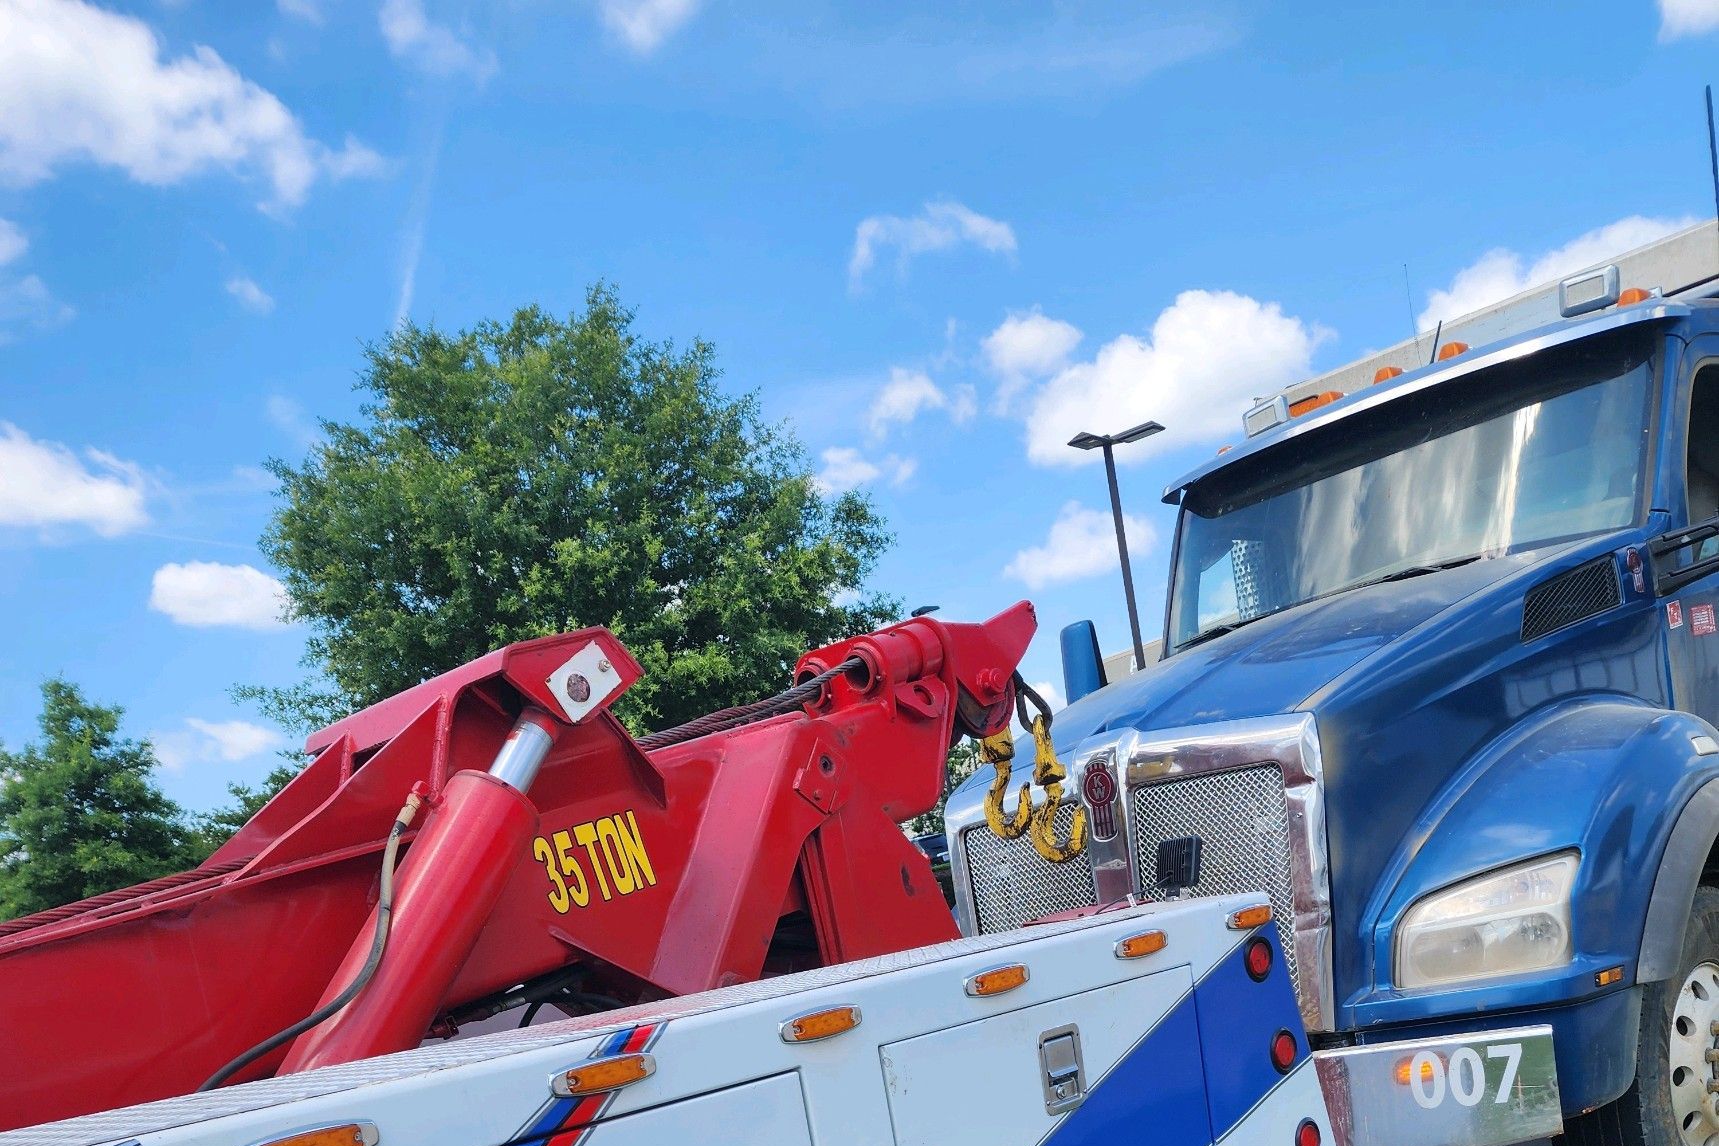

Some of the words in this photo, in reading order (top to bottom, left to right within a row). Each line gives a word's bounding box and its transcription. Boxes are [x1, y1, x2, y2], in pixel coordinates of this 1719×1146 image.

[533, 830, 590, 915] 35
[572, 809, 658, 902] TON
[1410, 1043, 1523, 1110] 007
